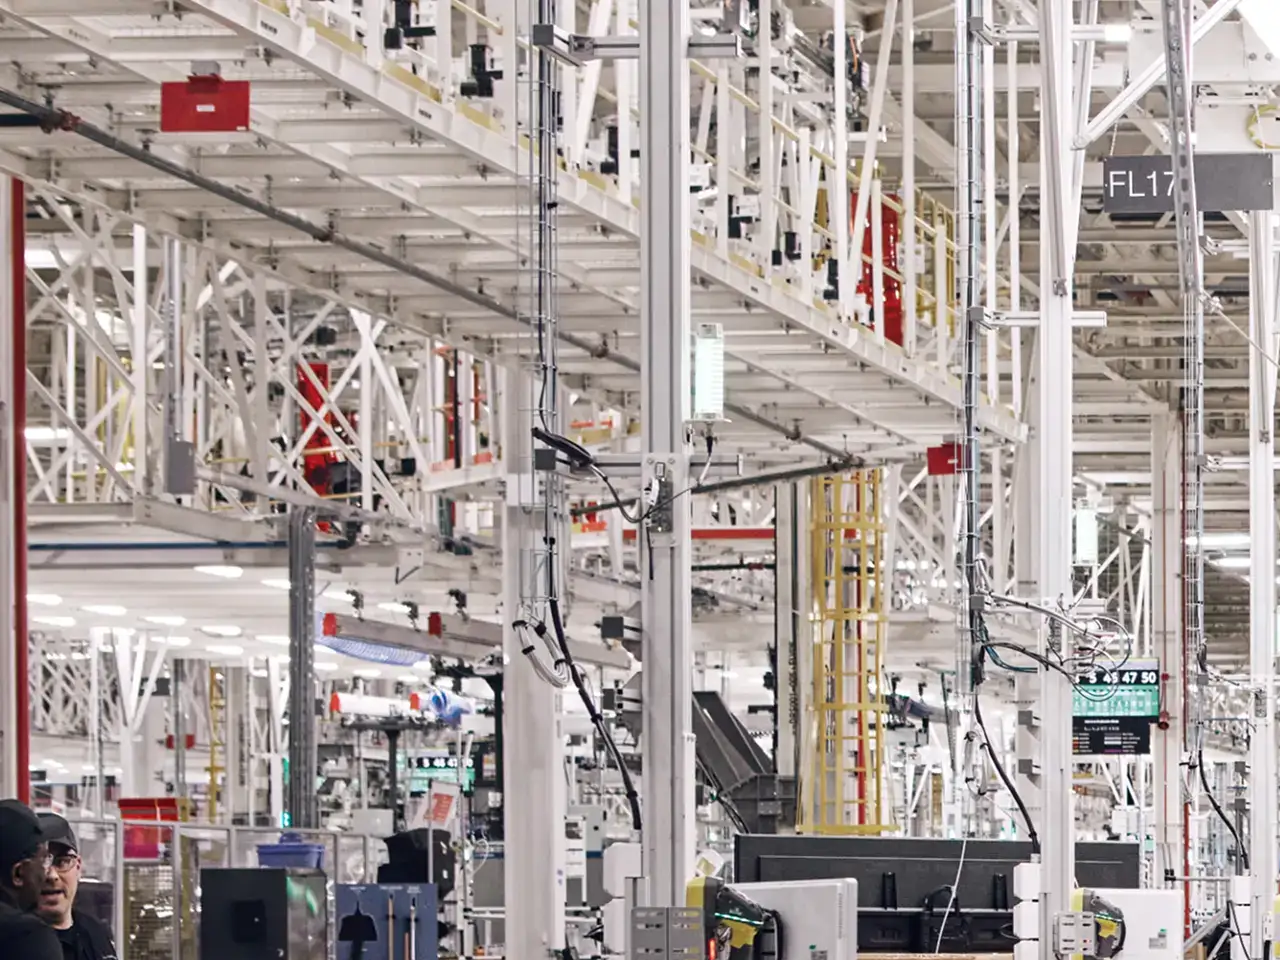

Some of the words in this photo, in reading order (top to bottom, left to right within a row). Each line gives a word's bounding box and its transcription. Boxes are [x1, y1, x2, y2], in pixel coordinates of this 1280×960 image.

[1109, 170, 1175, 197] FL17
[1122, 672, 1137, 684] 47
[1141, 672, 1157, 684] 50
